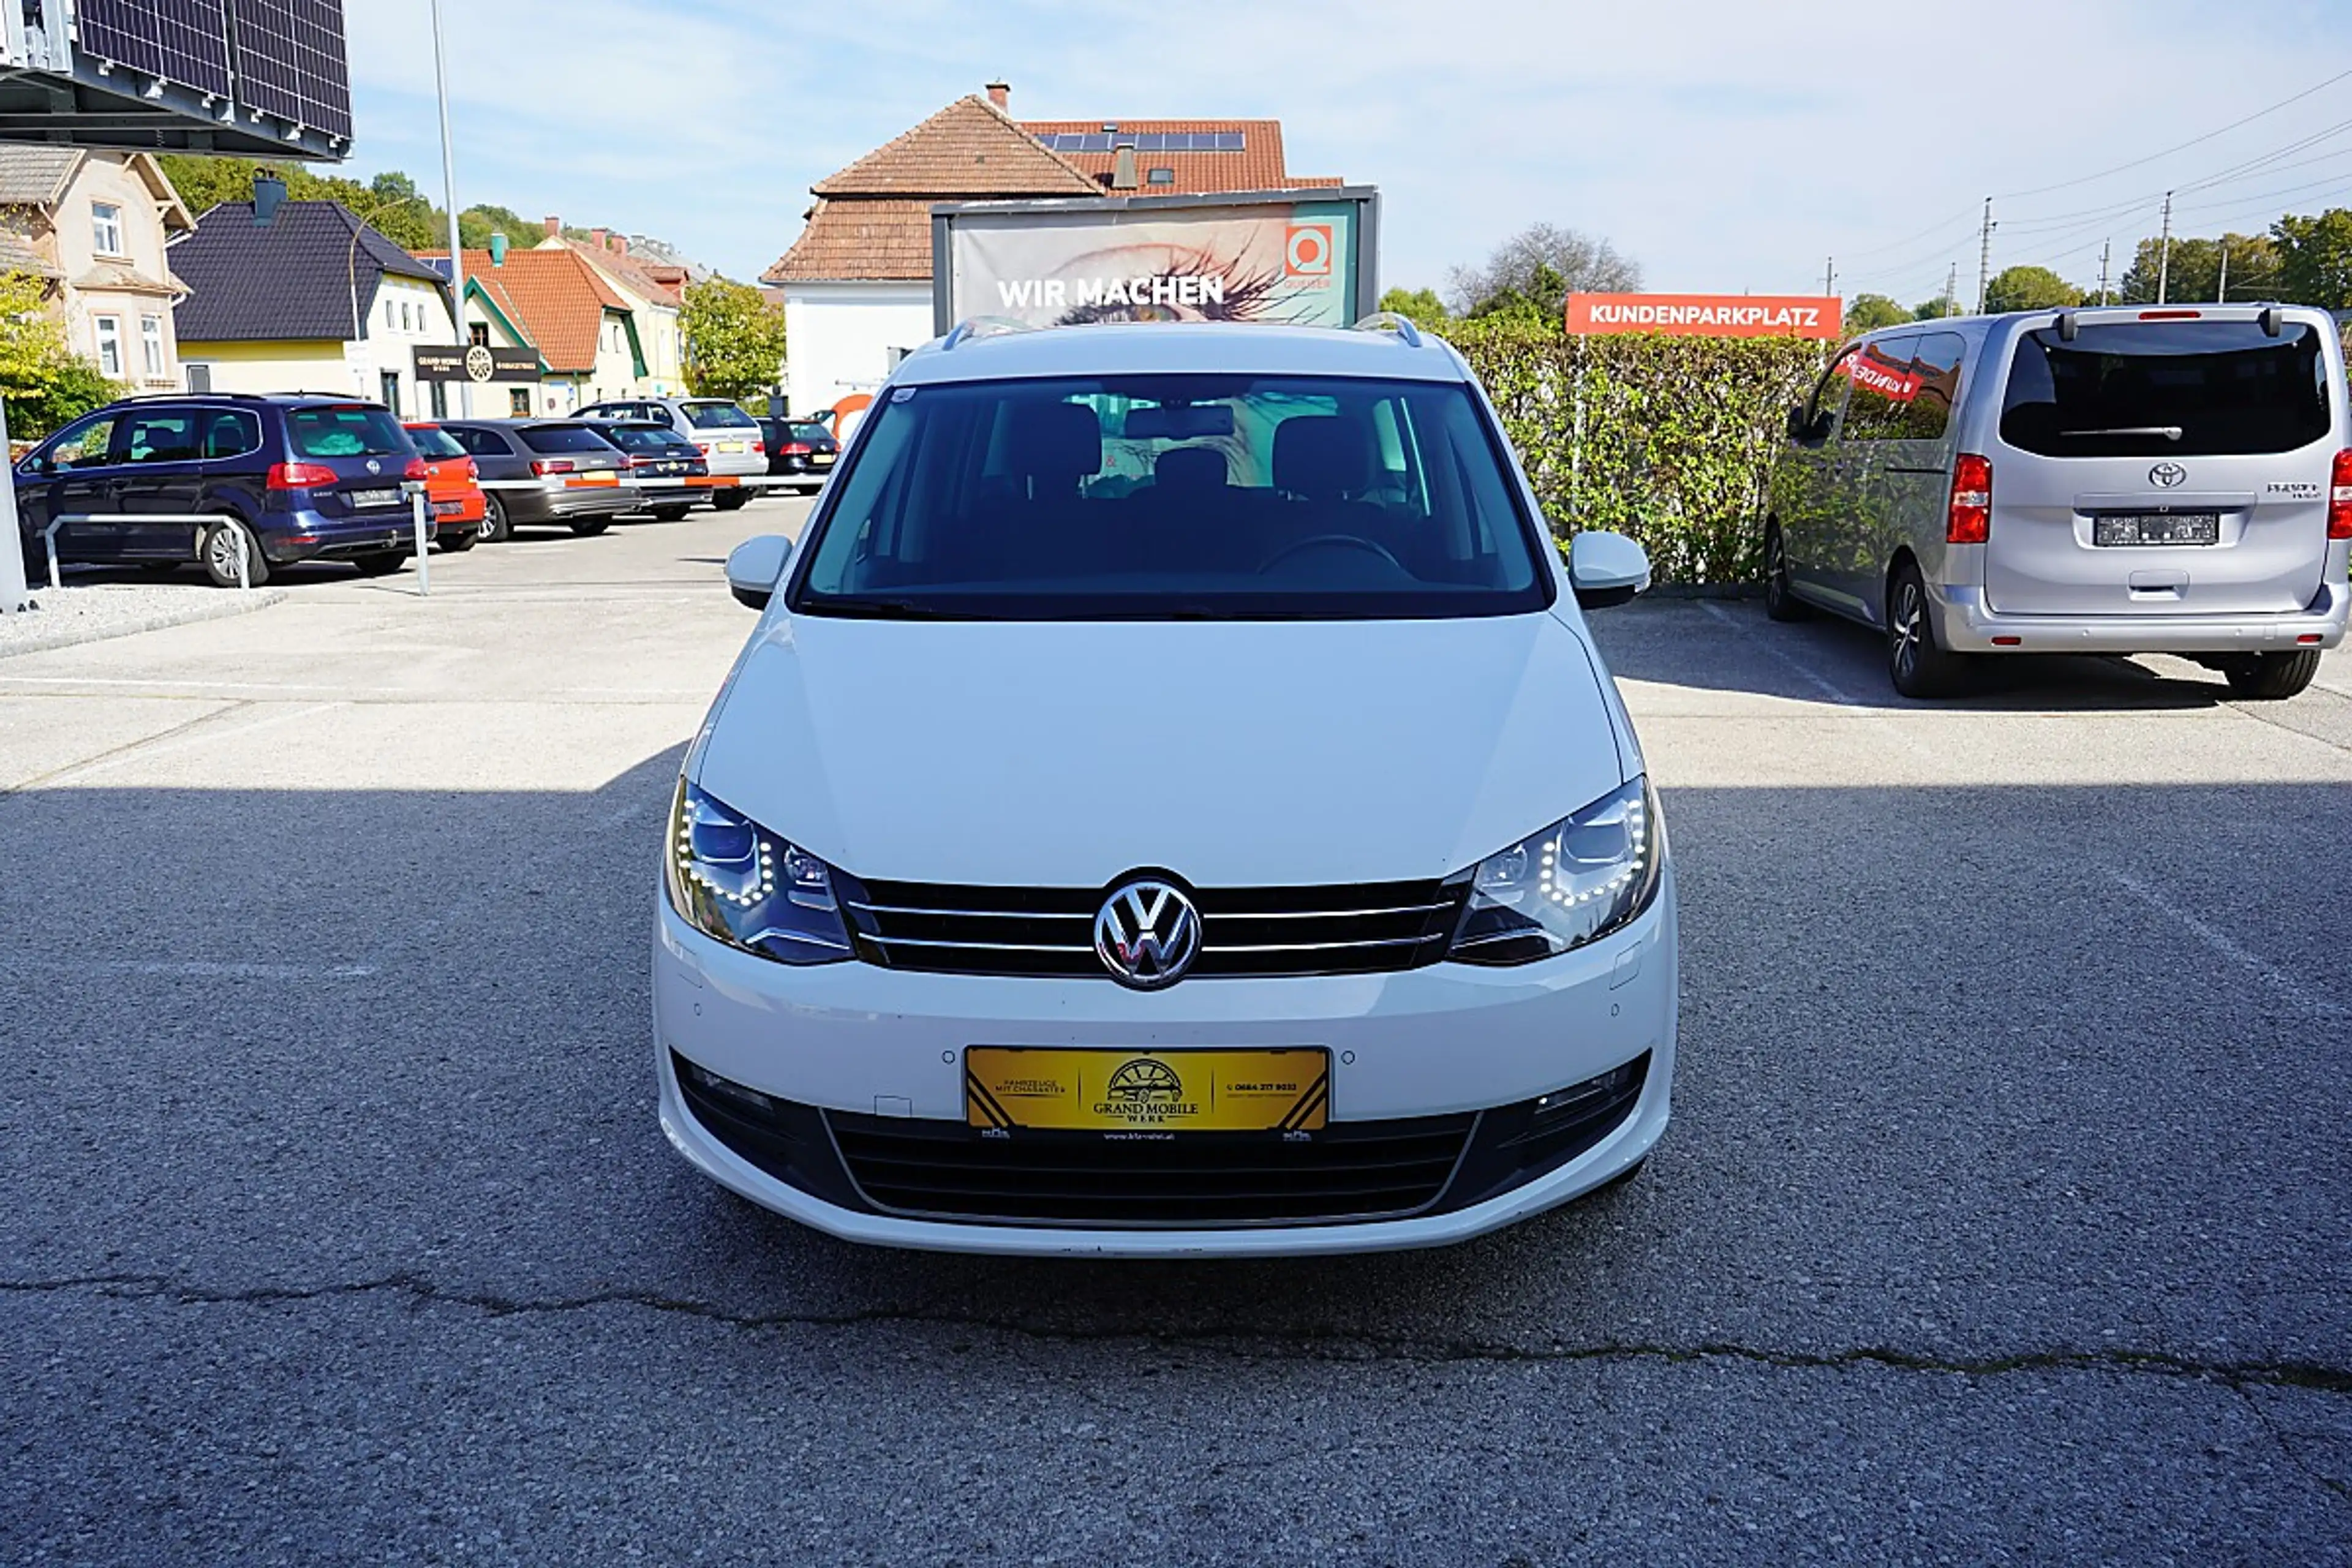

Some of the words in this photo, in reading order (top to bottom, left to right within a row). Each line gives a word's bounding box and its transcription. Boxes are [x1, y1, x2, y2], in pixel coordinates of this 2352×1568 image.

[997, 279, 1066, 307] WIR
[1077, 276, 1225, 306] MACHEN
[1589, 305, 1819, 326] KUNDENPARKPLATZ
[1098, 883, 1196, 981] VW
[1093, 1103, 1144, 1114] GRAND
[1146, 1103, 1199, 1114] MOBILE
